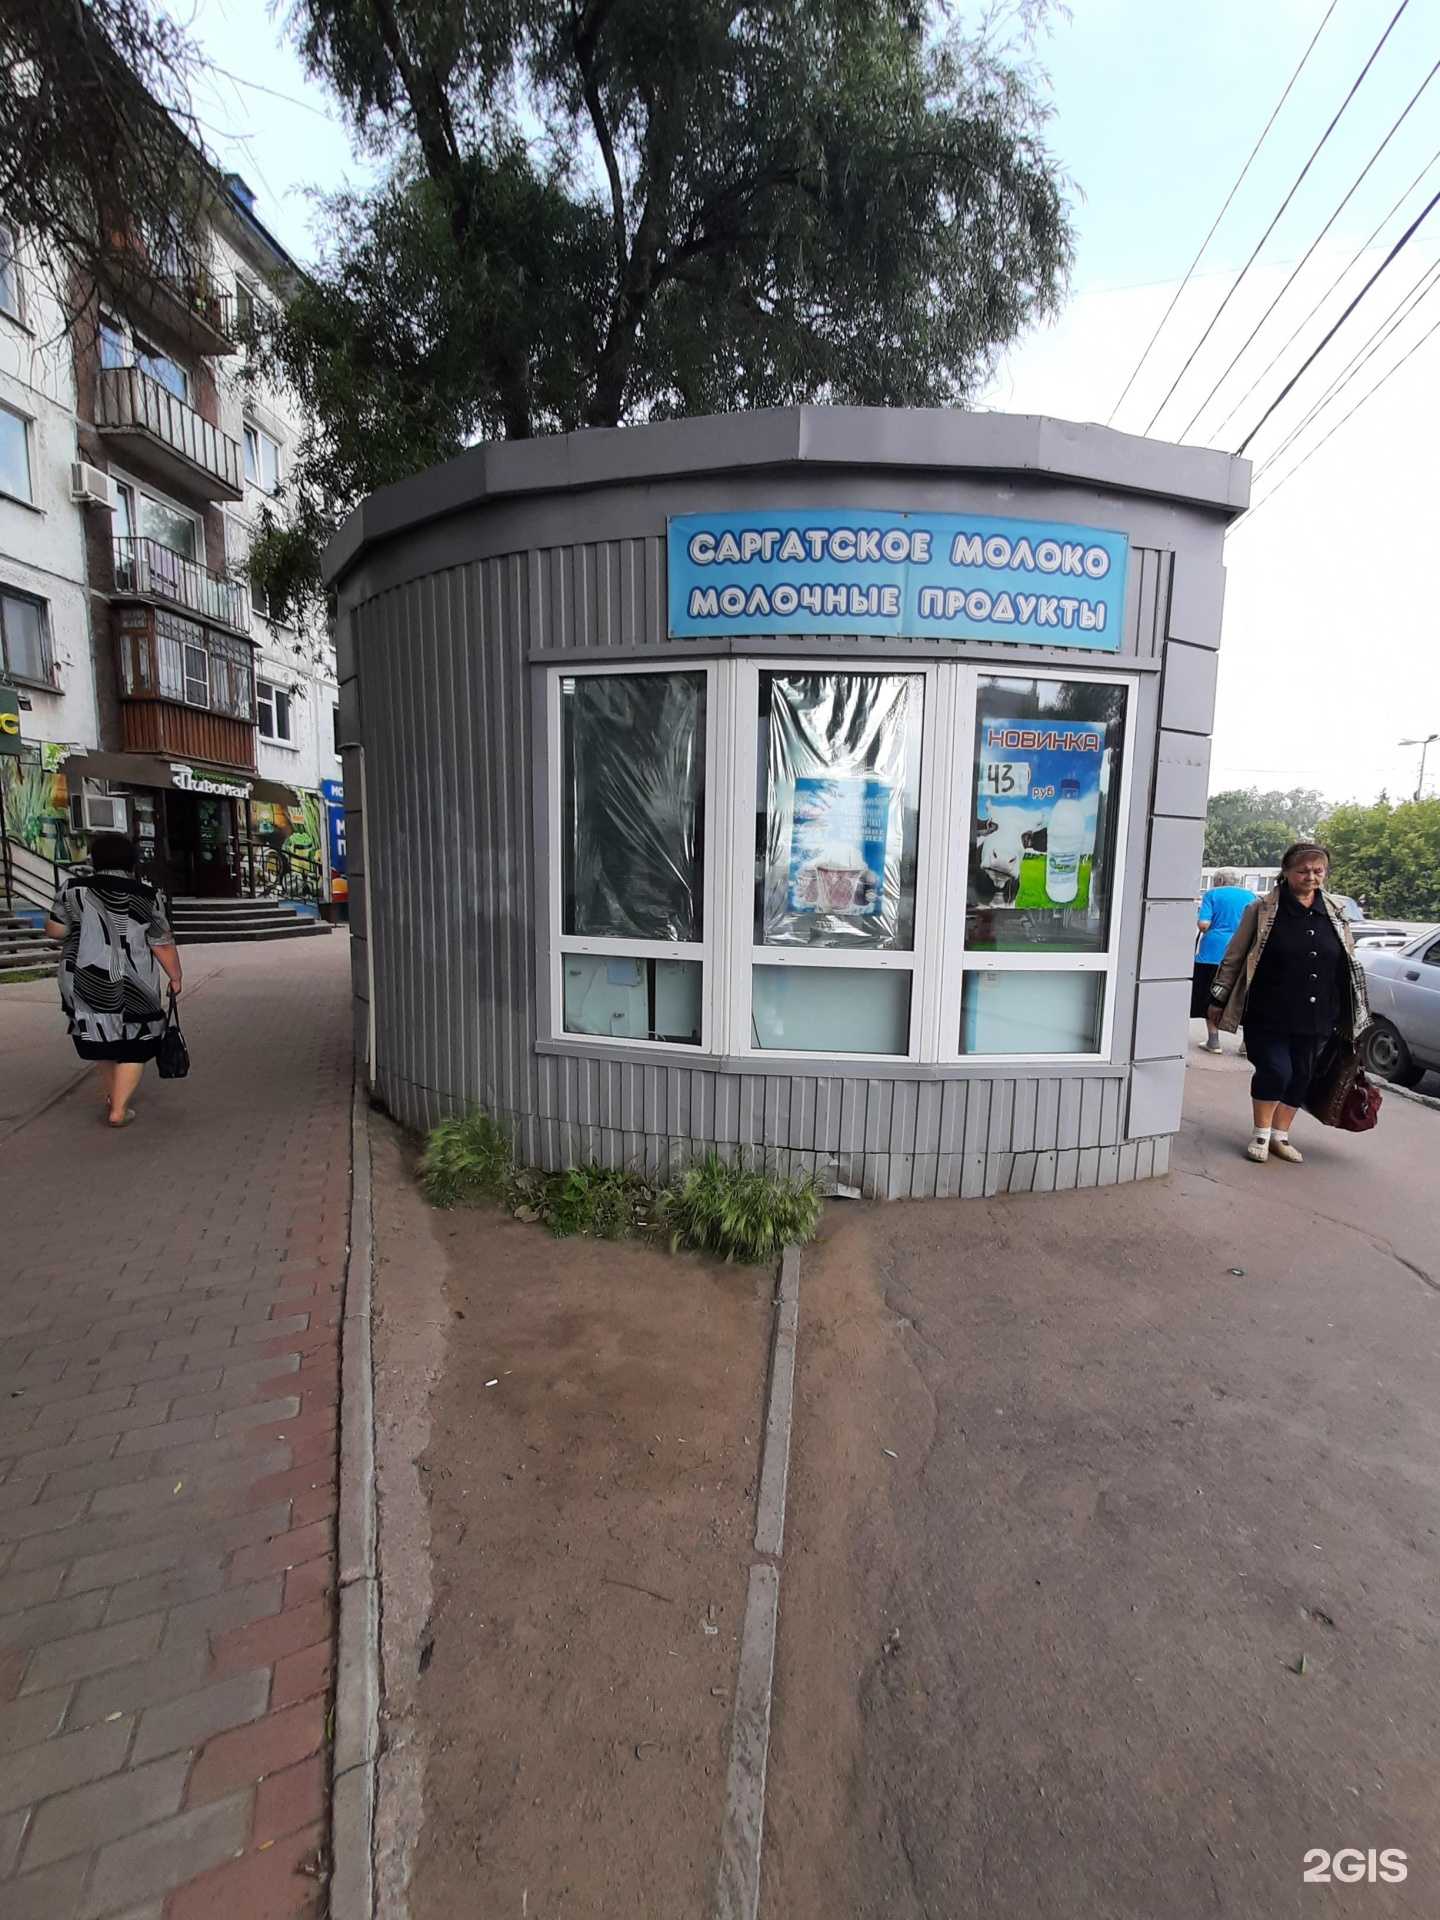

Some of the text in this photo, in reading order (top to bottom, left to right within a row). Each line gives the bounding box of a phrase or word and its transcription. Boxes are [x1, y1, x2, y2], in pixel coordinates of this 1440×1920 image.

[689, 529, 1110, 579] САРГАТСКОЕ МОЛОКО
[688, 584, 1106, 630] МОЛОЧНЫЕ ПРОДУКТЫ
[988, 729, 1100, 752] НОВИНКА
[988, 764, 1055, 800] 43 руб
